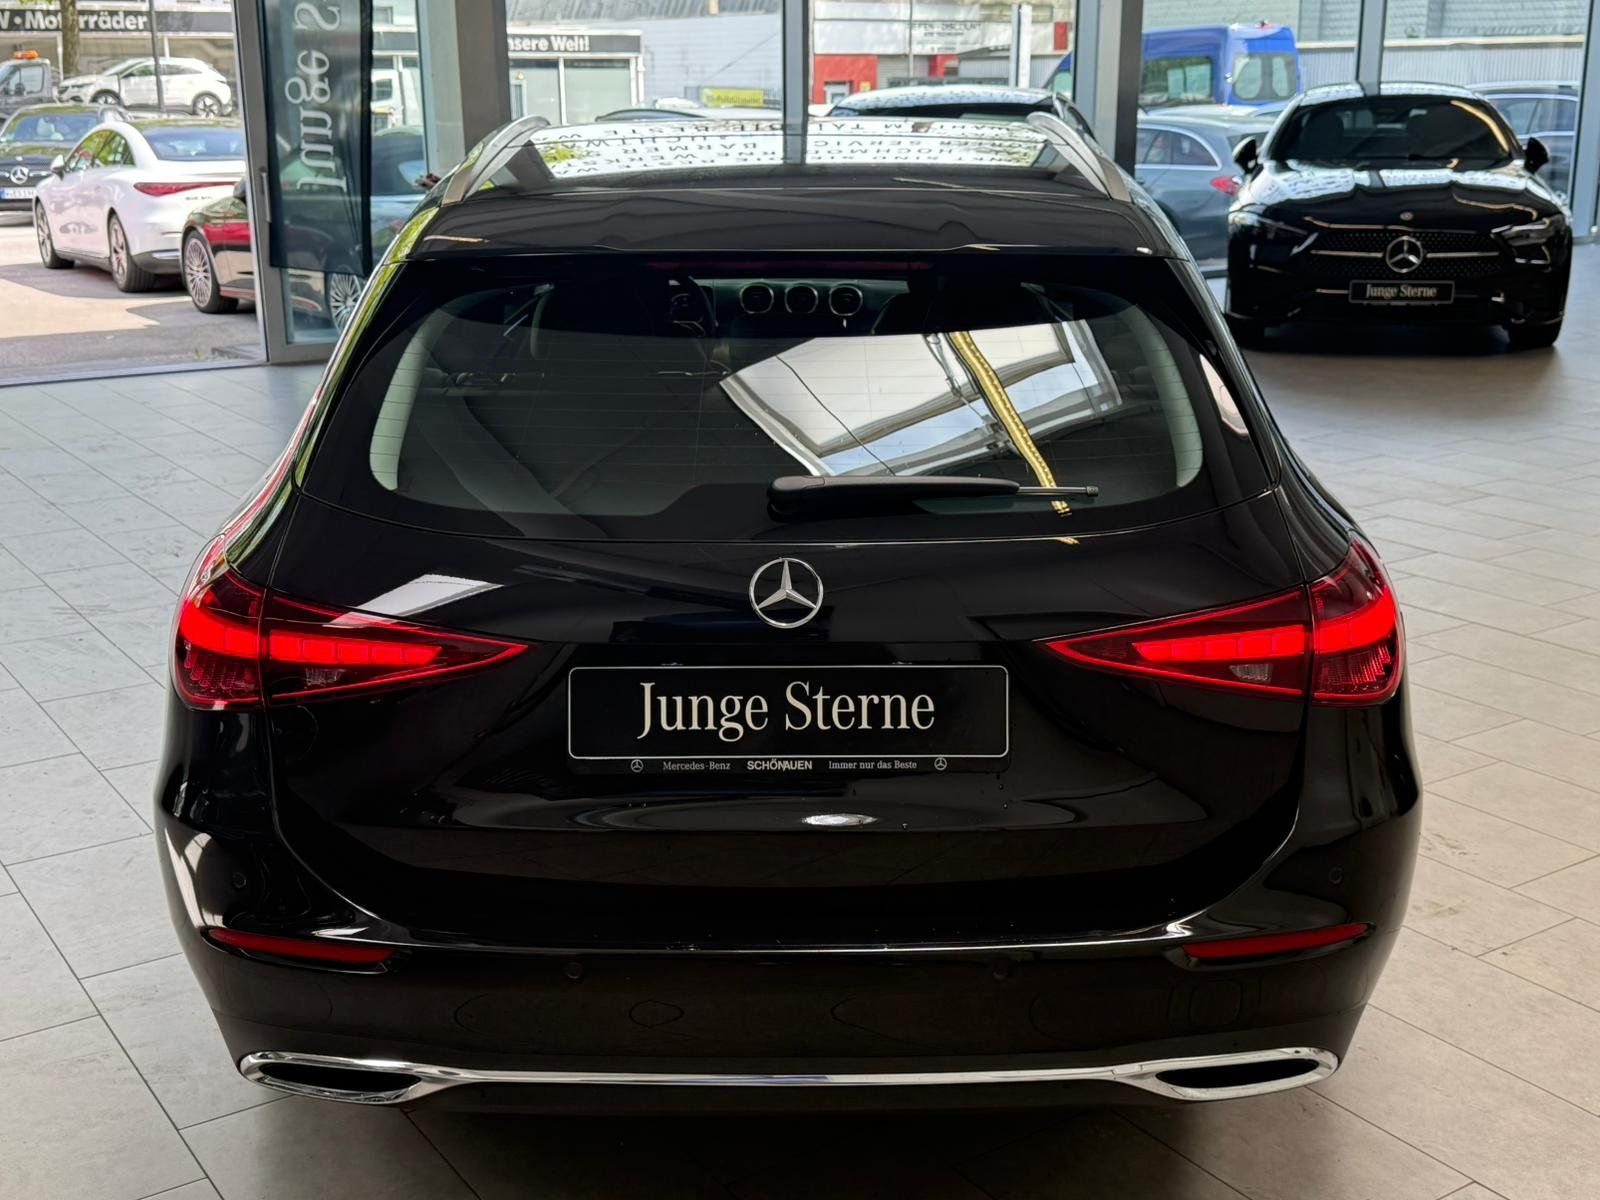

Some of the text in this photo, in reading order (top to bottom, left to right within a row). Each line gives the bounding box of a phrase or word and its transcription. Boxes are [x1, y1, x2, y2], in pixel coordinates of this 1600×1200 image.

[550, 35, 590, 51] Welt!
[1365, 283, 1437, 299] Junge Sterne
[637, 680, 936, 742] Junge Sterne
[662, 760, 731, 771] Mercedes-Benz
[828, 759, 856, 770] Immer
[858, 761, 875, 770] nur
[877, 760, 892, 770] das
[894, 759, 918, 770] Beste
